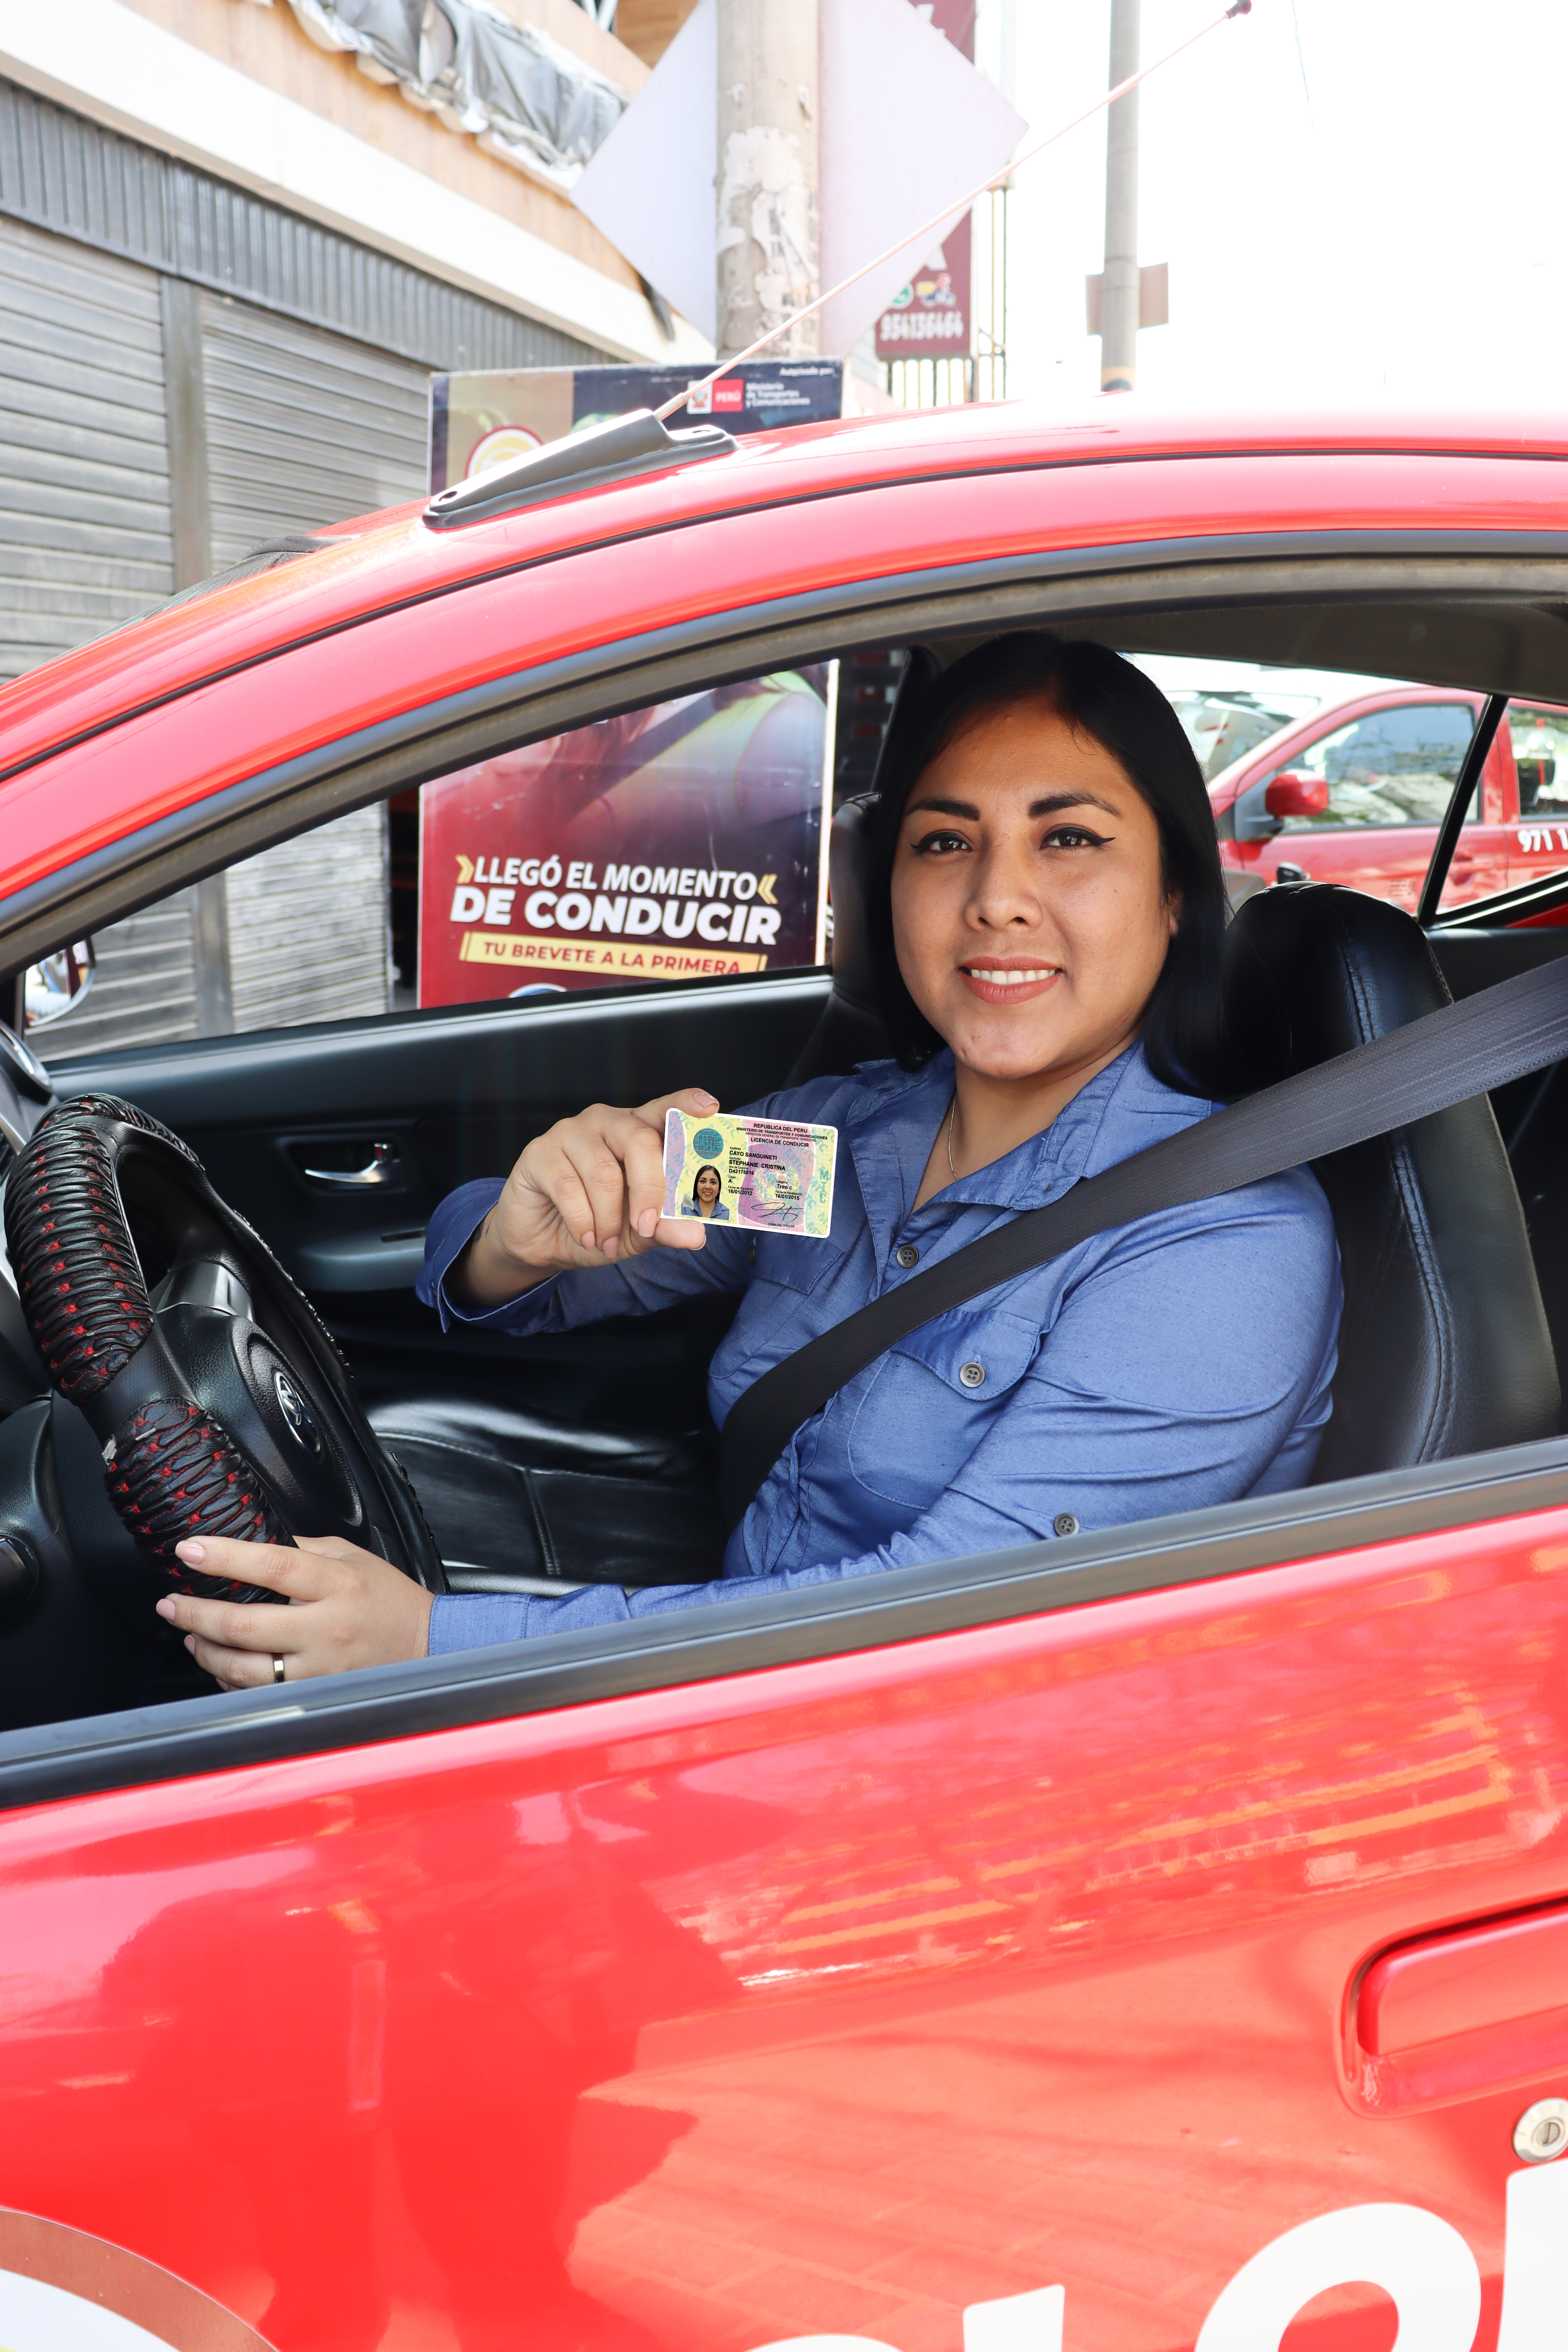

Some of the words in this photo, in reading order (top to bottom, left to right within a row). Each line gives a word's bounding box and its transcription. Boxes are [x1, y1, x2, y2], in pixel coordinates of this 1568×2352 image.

[780, 367, 818, 376] Autorizado
[746, 381, 784, 390] Ministerio
[715, 390, 742, 403] PERÚ
[757, 390, 800, 399] Transportes
[752, 397, 811, 407] Comunicaciones
[1517, 828, 1553, 853] 971
[1556, 827, 1568, 851] 1
[474, 854, 563, 887] LLEGÓ
[565, 861, 598, 890] EL
[601, 863, 758, 901] MOMENTO
[450, 885, 516, 926] DE
[524, 890, 782, 945] CONDUCIR
[484, 942, 506, 956] TU
[512, 944, 596, 963] BREVETE
[601, 951, 613, 965] A
[621, 953, 644, 967] LA
[651, 955, 740, 974] PRIMERA
[745, 1152, 777, 1160] SANGUINETI
